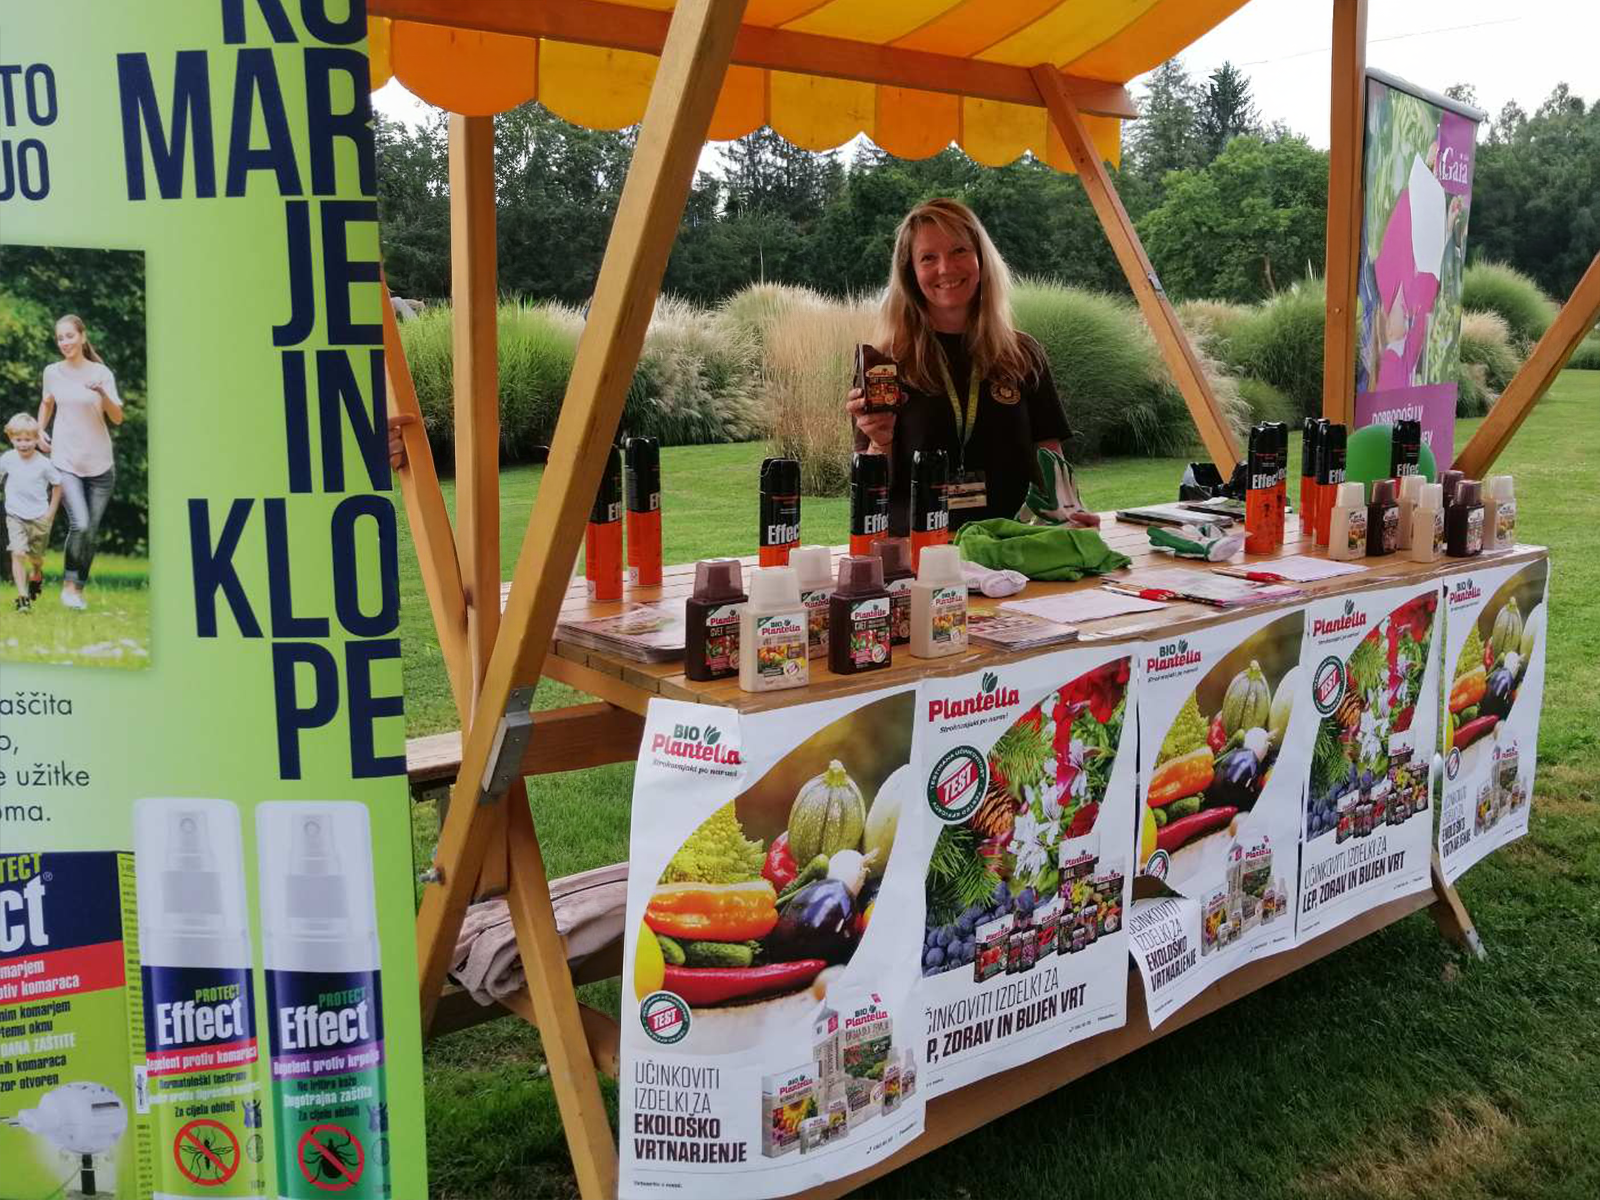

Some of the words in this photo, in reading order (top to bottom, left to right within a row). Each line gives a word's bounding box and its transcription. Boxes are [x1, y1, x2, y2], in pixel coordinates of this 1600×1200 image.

[116, 47, 377, 201] MAR
[272, 200, 384, 347] JE
[281, 348, 393, 494] IN
[188, 494, 400, 638] KLO
[761, 624, 801, 636] Plantella
[1312, 610, 1366, 637] Plantella
[1146, 649, 1202, 673] Plantella
[1159, 643, 1176, 657] BIO
[0, 691, 72, 716] aščita
[272, 638, 408, 780] PE
[928, 685, 1020, 723] Plantella
[673, 723, 700, 741] BIO
[652, 733, 742, 765] Plantella
[16, 759, 91, 787] užitke
[943, 762, 973, 803] TEST
[0, 805, 52, 822] ma.
[1319, 873, 1347, 905] ZDRAV
[1348, 868, 1358, 890] IN
[1358, 857, 1386, 885] BUJEN
[1387, 850, 1406, 873] VRT
[21, 974, 80, 997] komaraca
[195, 983, 241, 1004] PROTECT
[318, 986, 367, 1009] PROTECT
[995, 971, 1042, 1012] IZDELKI
[1044, 966, 1060, 993] ZA
[20, 1000, 71, 1019] komarjem
[156, 997, 244, 1046] Effect
[653, 1007, 677, 1030] TEST
[845, 1009, 889, 1029] Plantella
[855, 1007, 868, 1018] BIO
[942, 1018, 995, 1058] ZDRAV
[996, 1013, 1013, 1039] IN
[1015, 994, 1057, 1033] BUJEN
[1060, 983, 1087, 1013] VRT
[279, 1000, 370, 1051] Effect
[16, 1054, 67, 1074] komaraca
[183, 1051, 214, 1069] protiv
[313, 1055, 345, 1074] protiv
[20, 1073, 59, 1090] otvoren
[634, 1059, 720, 1090] UČINKOVITI
[175, 1106, 187, 1118] Za
[634, 1087, 691, 1113] IZDELKI
[692, 1091, 712, 1114] ZA
[634, 1112, 721, 1139] EKOLOŠKO
[634, 1138, 748, 1163] VRTNARJENJE
